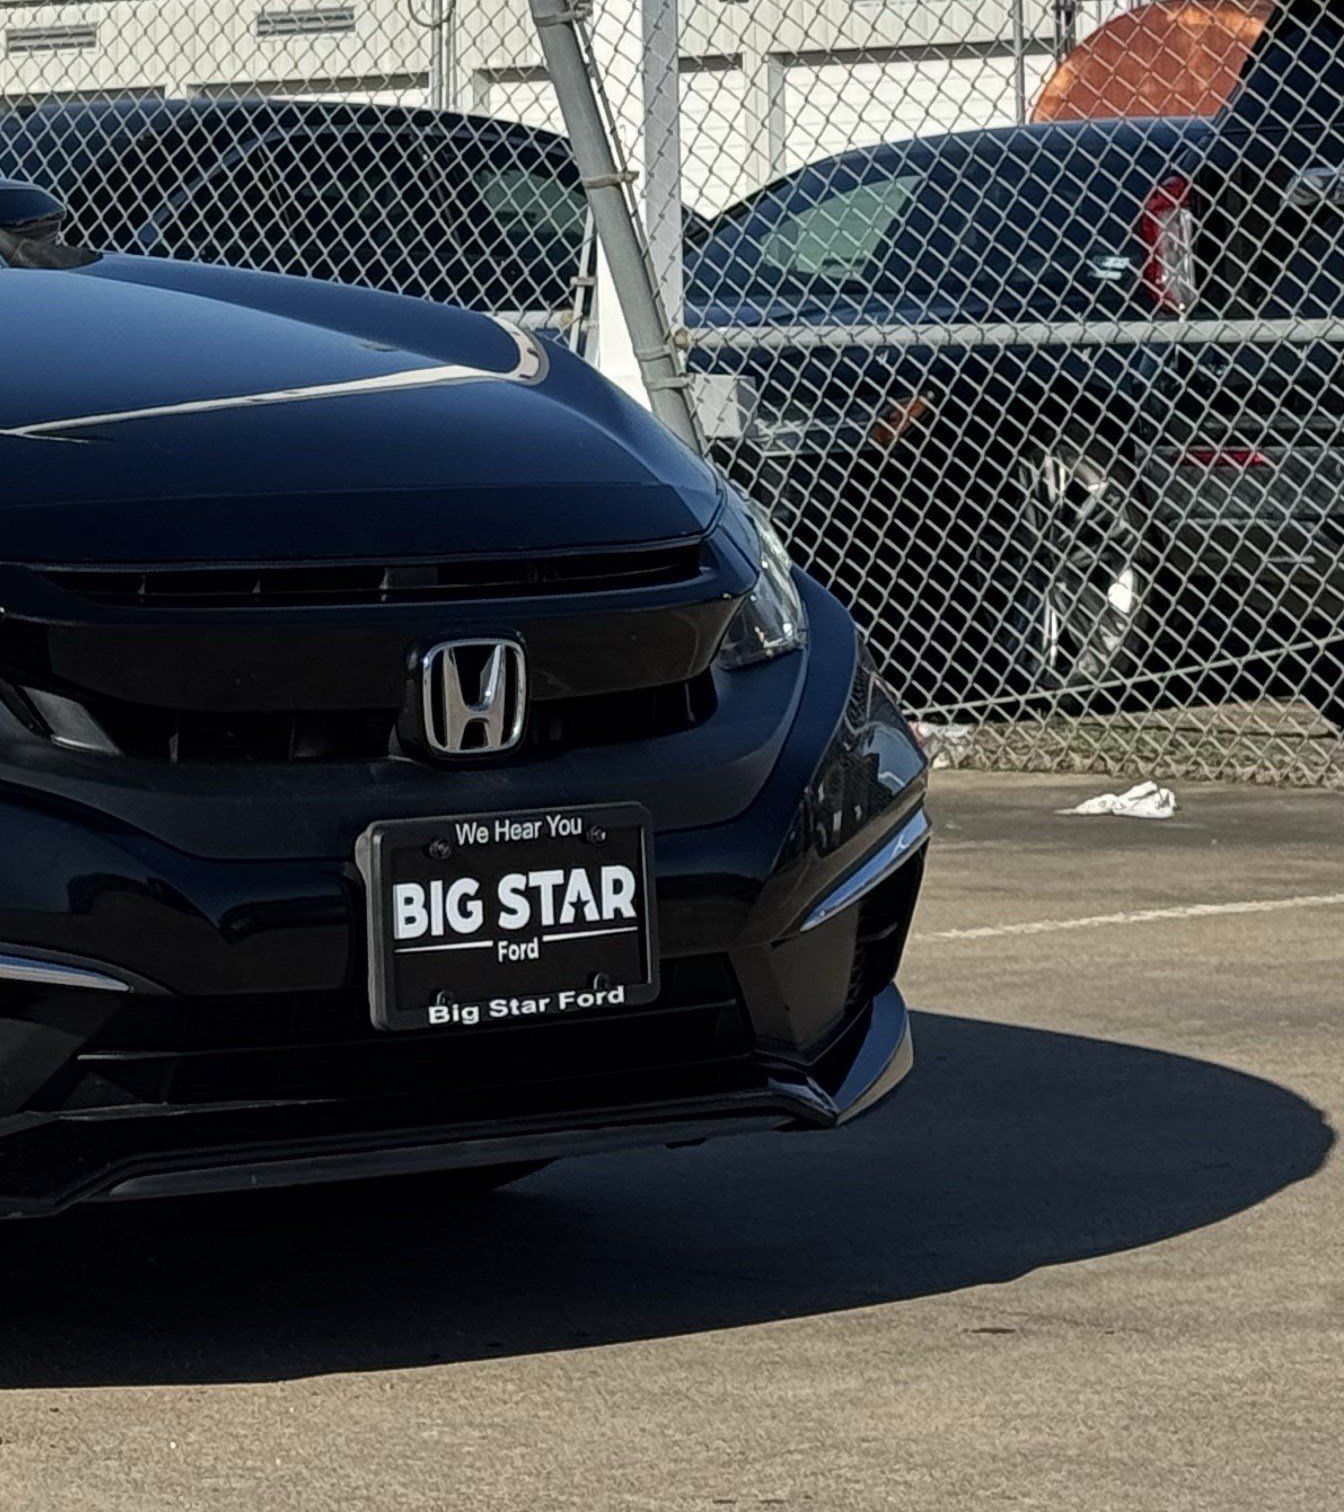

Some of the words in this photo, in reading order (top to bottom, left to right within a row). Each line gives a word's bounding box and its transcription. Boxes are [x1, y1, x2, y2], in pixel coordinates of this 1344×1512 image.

[455, 822, 489, 845] We
[495, 819, 542, 841] Hear
[547, 815, 581, 836] You
[393, 878, 483, 939] BIG
[498, 865, 637, 929] STAR
[498, 937, 538, 962] Ford
[429, 1005, 479, 1024] Big
[490, 998, 550, 1017] Star
[559, 985, 624, 1009] Ford
